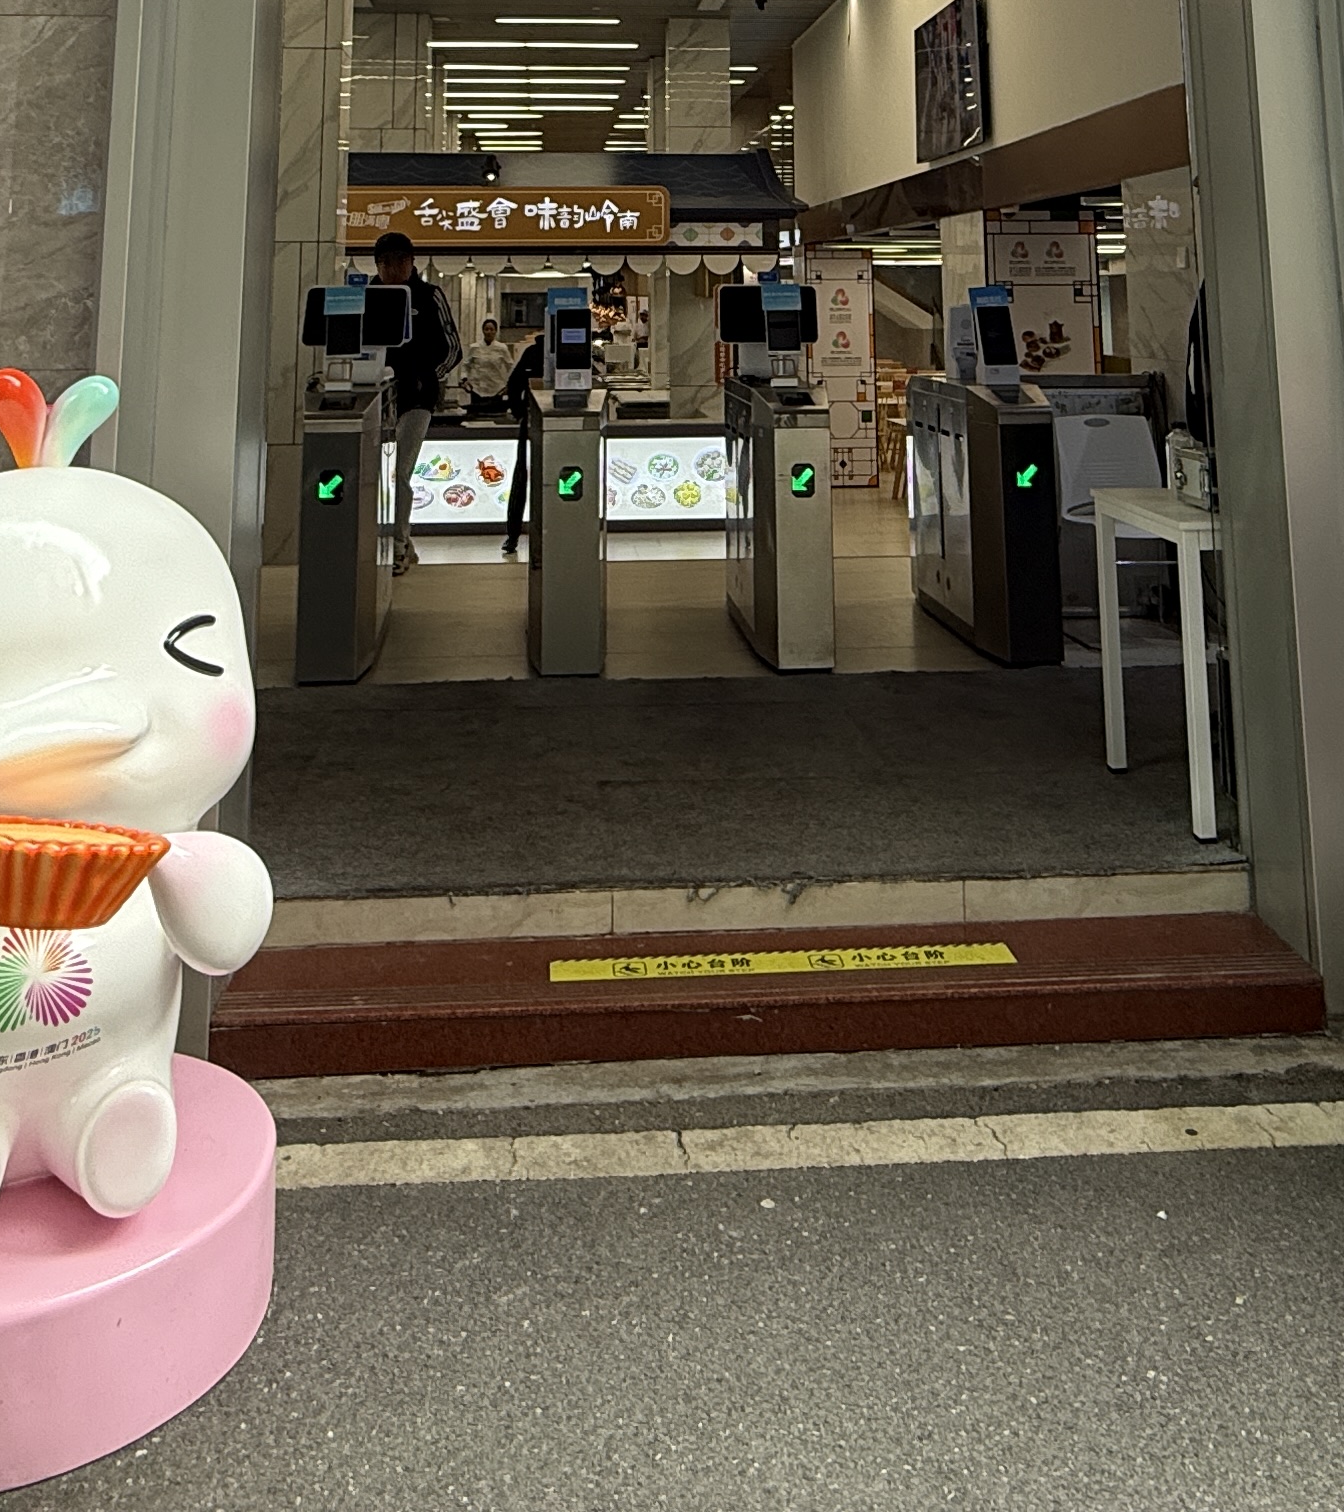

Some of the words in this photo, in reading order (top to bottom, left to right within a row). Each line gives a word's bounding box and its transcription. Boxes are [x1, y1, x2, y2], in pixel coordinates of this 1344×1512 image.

[851, 949, 945, 962] 小心台阶
[656, 957, 752, 970] 小心台阶
[71, 1026, 101, 1047] 2025
